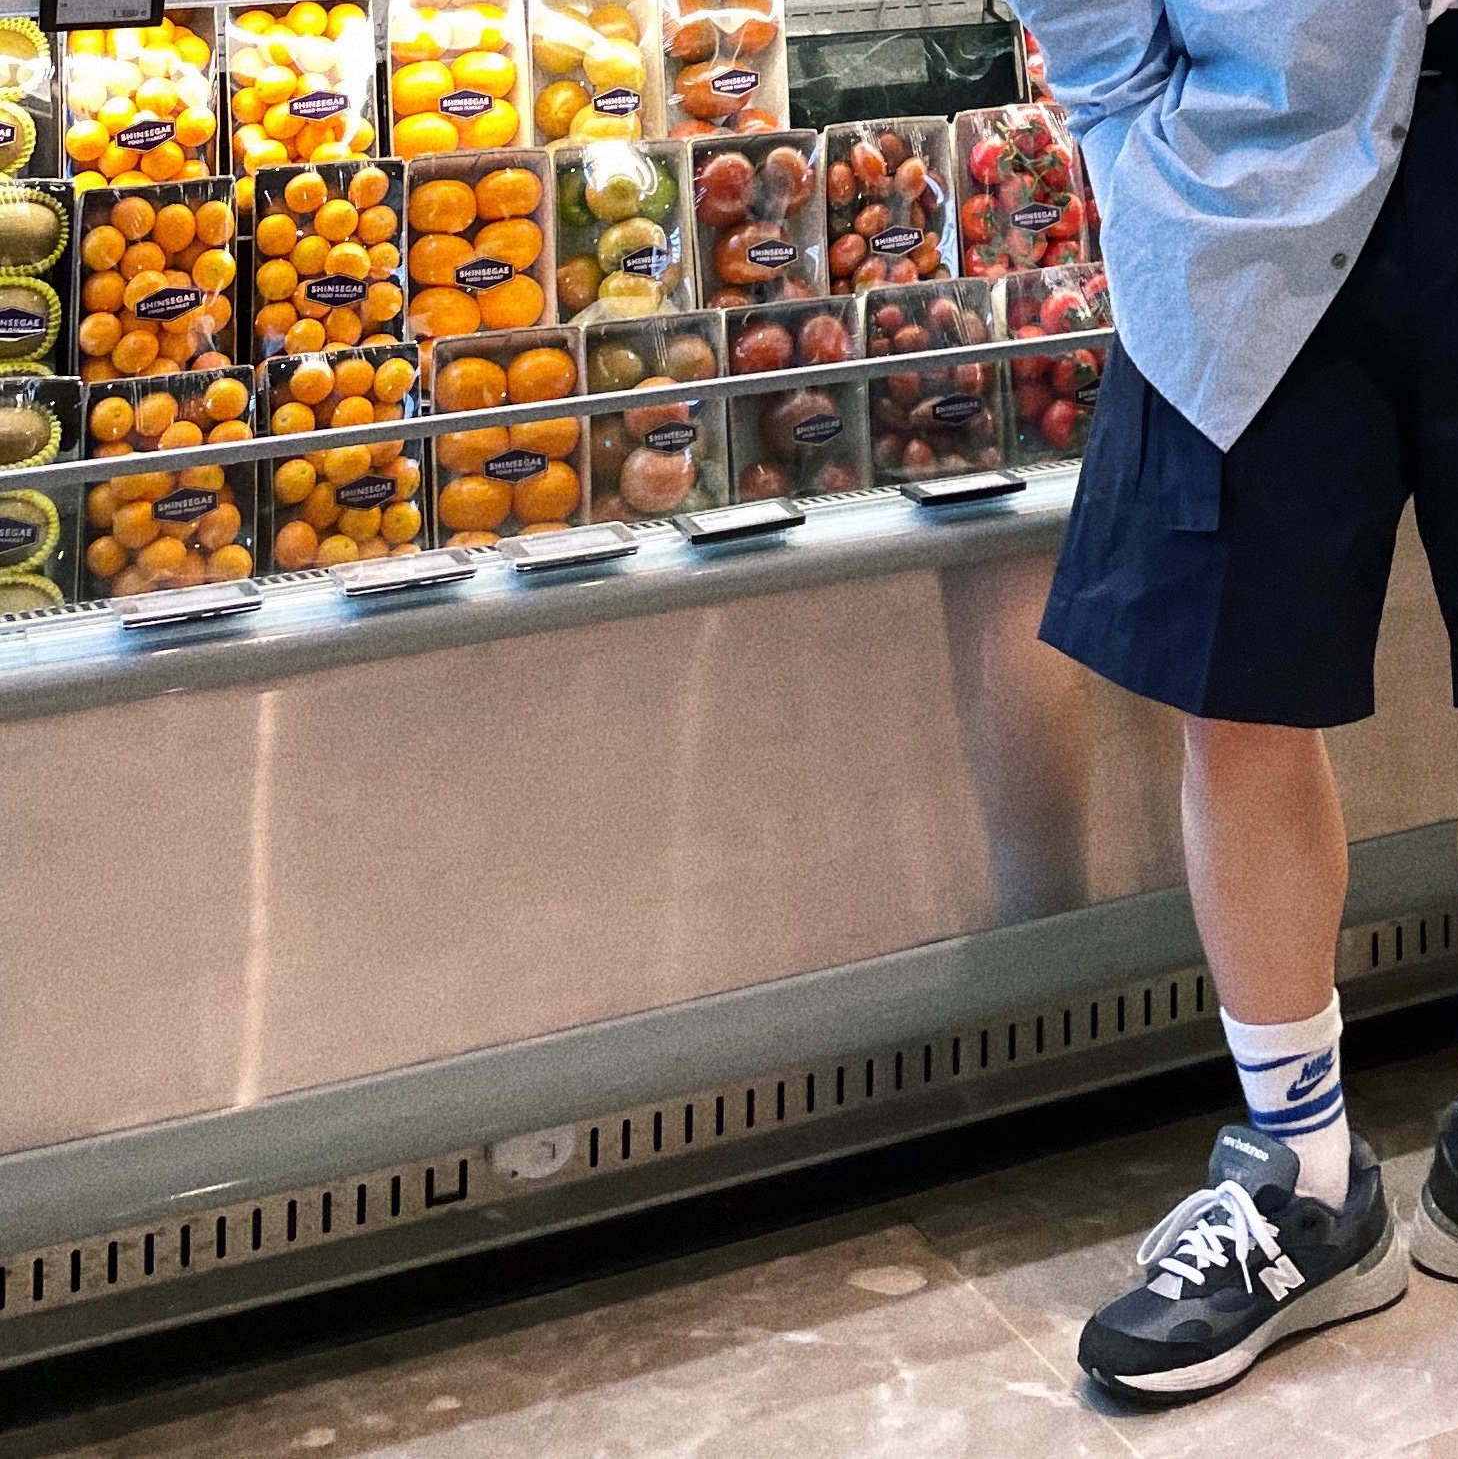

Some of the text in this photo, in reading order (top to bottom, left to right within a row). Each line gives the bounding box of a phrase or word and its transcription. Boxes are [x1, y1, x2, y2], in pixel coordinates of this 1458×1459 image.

[713, 74, 756, 88] SHINSEGAE
[292, 97, 345, 111] SHINSEGAE
[442, 96, 489, 108] SHINSEGAE
[121, 124, 172, 142] SHINSEGAE
[1015, 210, 1057, 222] SHINSEGAE
[874, 232, 919, 247] SHINSEGAE
[751, 248, 794, 258] SHINSEGAE
[459, 266, 510, 277] SHINSEGAE
[311, 284, 363, 293] SHINSEGAE
[139, 292, 196, 311] SHINSEGAE
[489, 458, 543, 471] SHINSEGAE
[340, 482, 393, 499] SHINSEGAE
[158, 495, 213, 512] SHINSEGAE
[1299, 1046, 1334, 1084] NIKE
[1258, 1254, 1306, 1302] N
